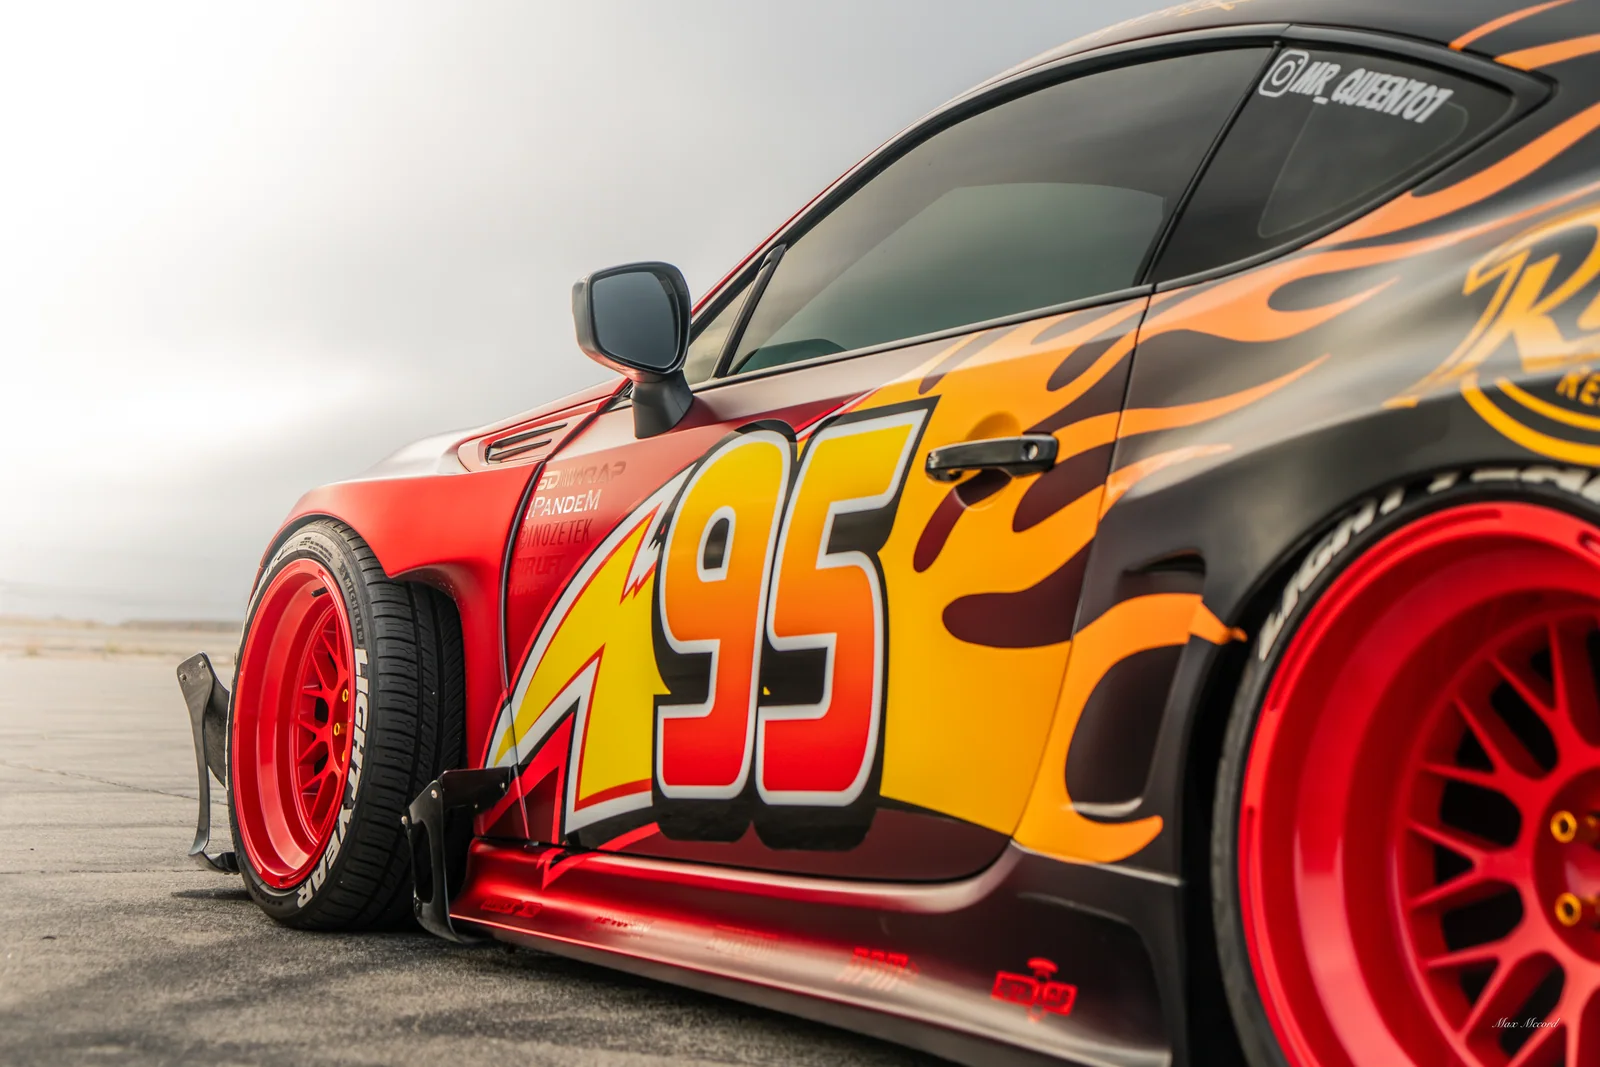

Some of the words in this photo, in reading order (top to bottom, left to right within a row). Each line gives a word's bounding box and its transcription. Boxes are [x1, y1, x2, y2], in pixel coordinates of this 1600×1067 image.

[526, 518, 594, 548] INOZETEK
[344, 577, 365, 641] MICHELIN
[655, 405, 935, 810] 95
